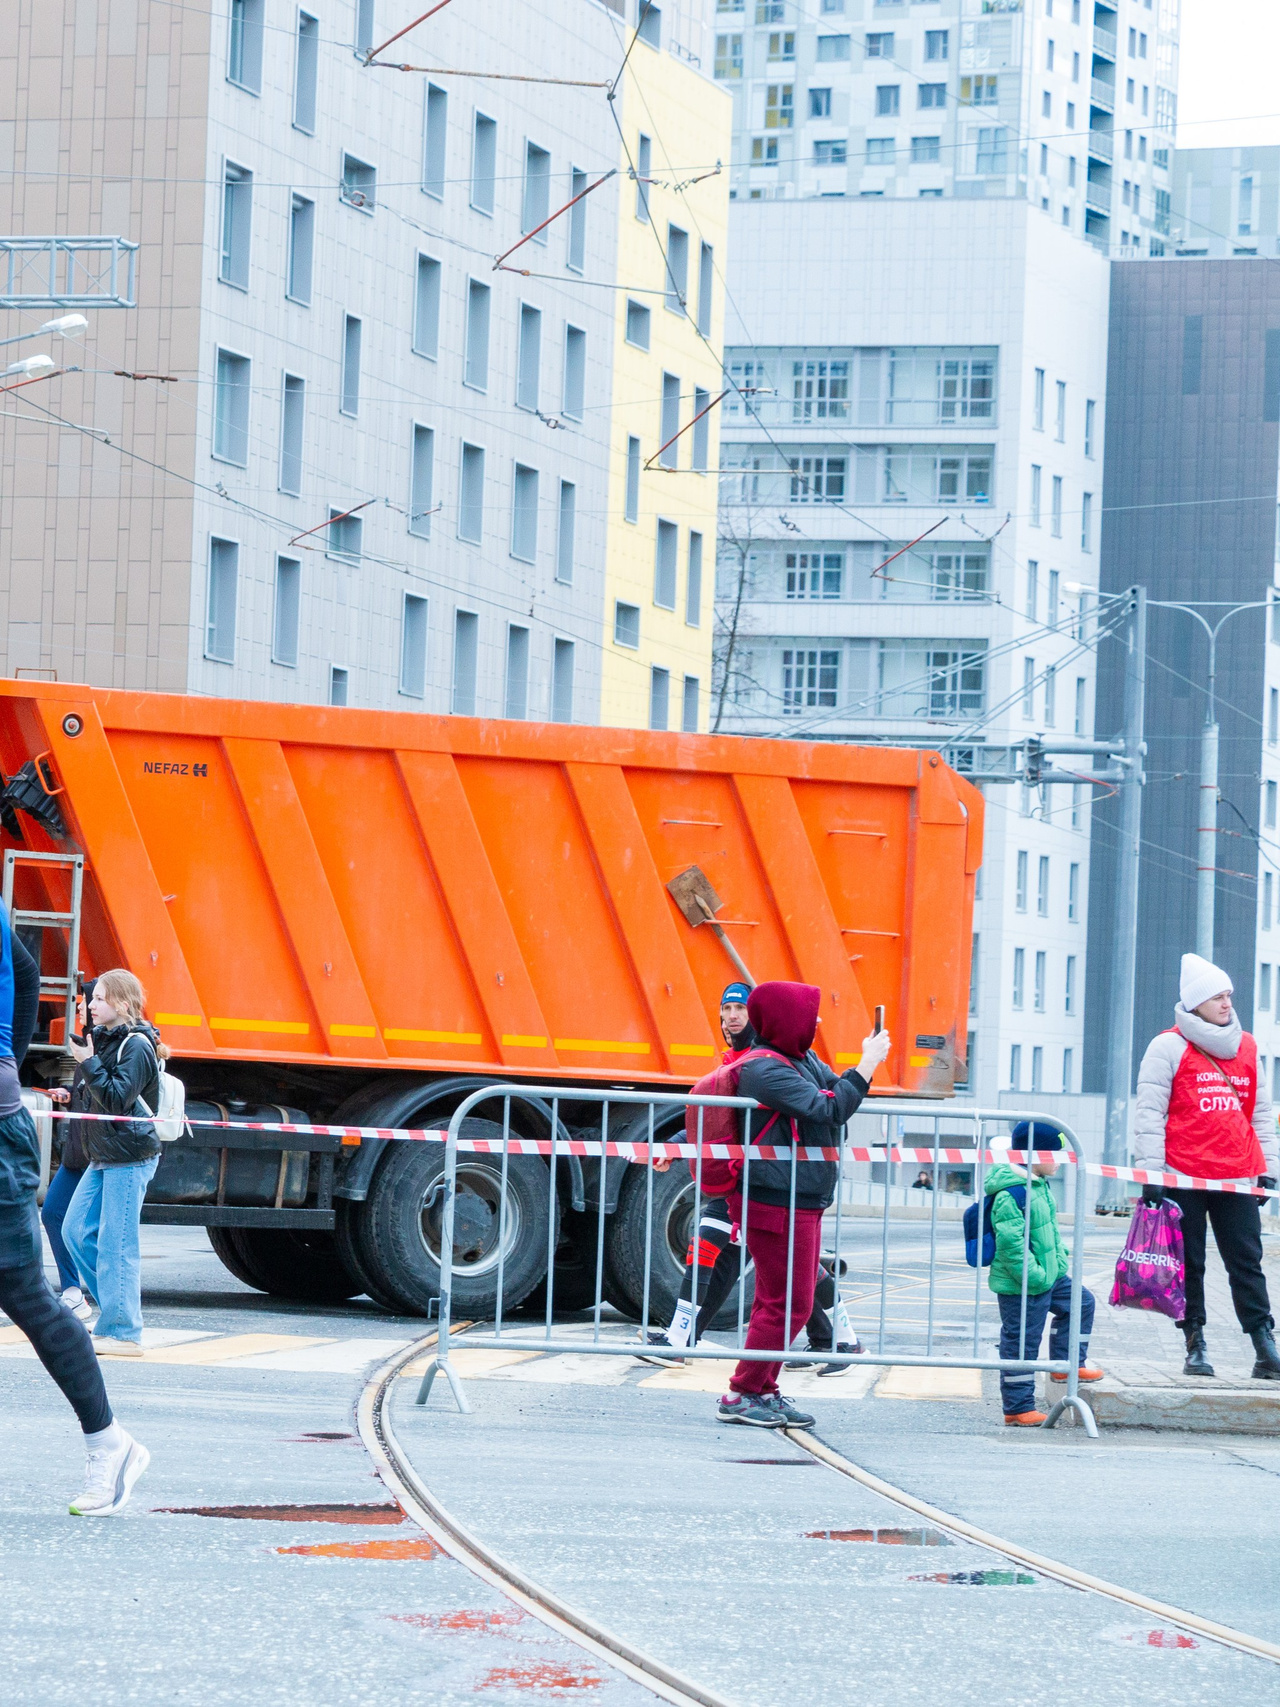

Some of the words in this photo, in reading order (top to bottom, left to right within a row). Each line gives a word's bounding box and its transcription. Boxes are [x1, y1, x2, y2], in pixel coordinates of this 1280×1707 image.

[143, 761, 189, 775] NEFAZ
[679, 1317, 690, 1330] 3
[840, 1315, 849, 1328] 2
